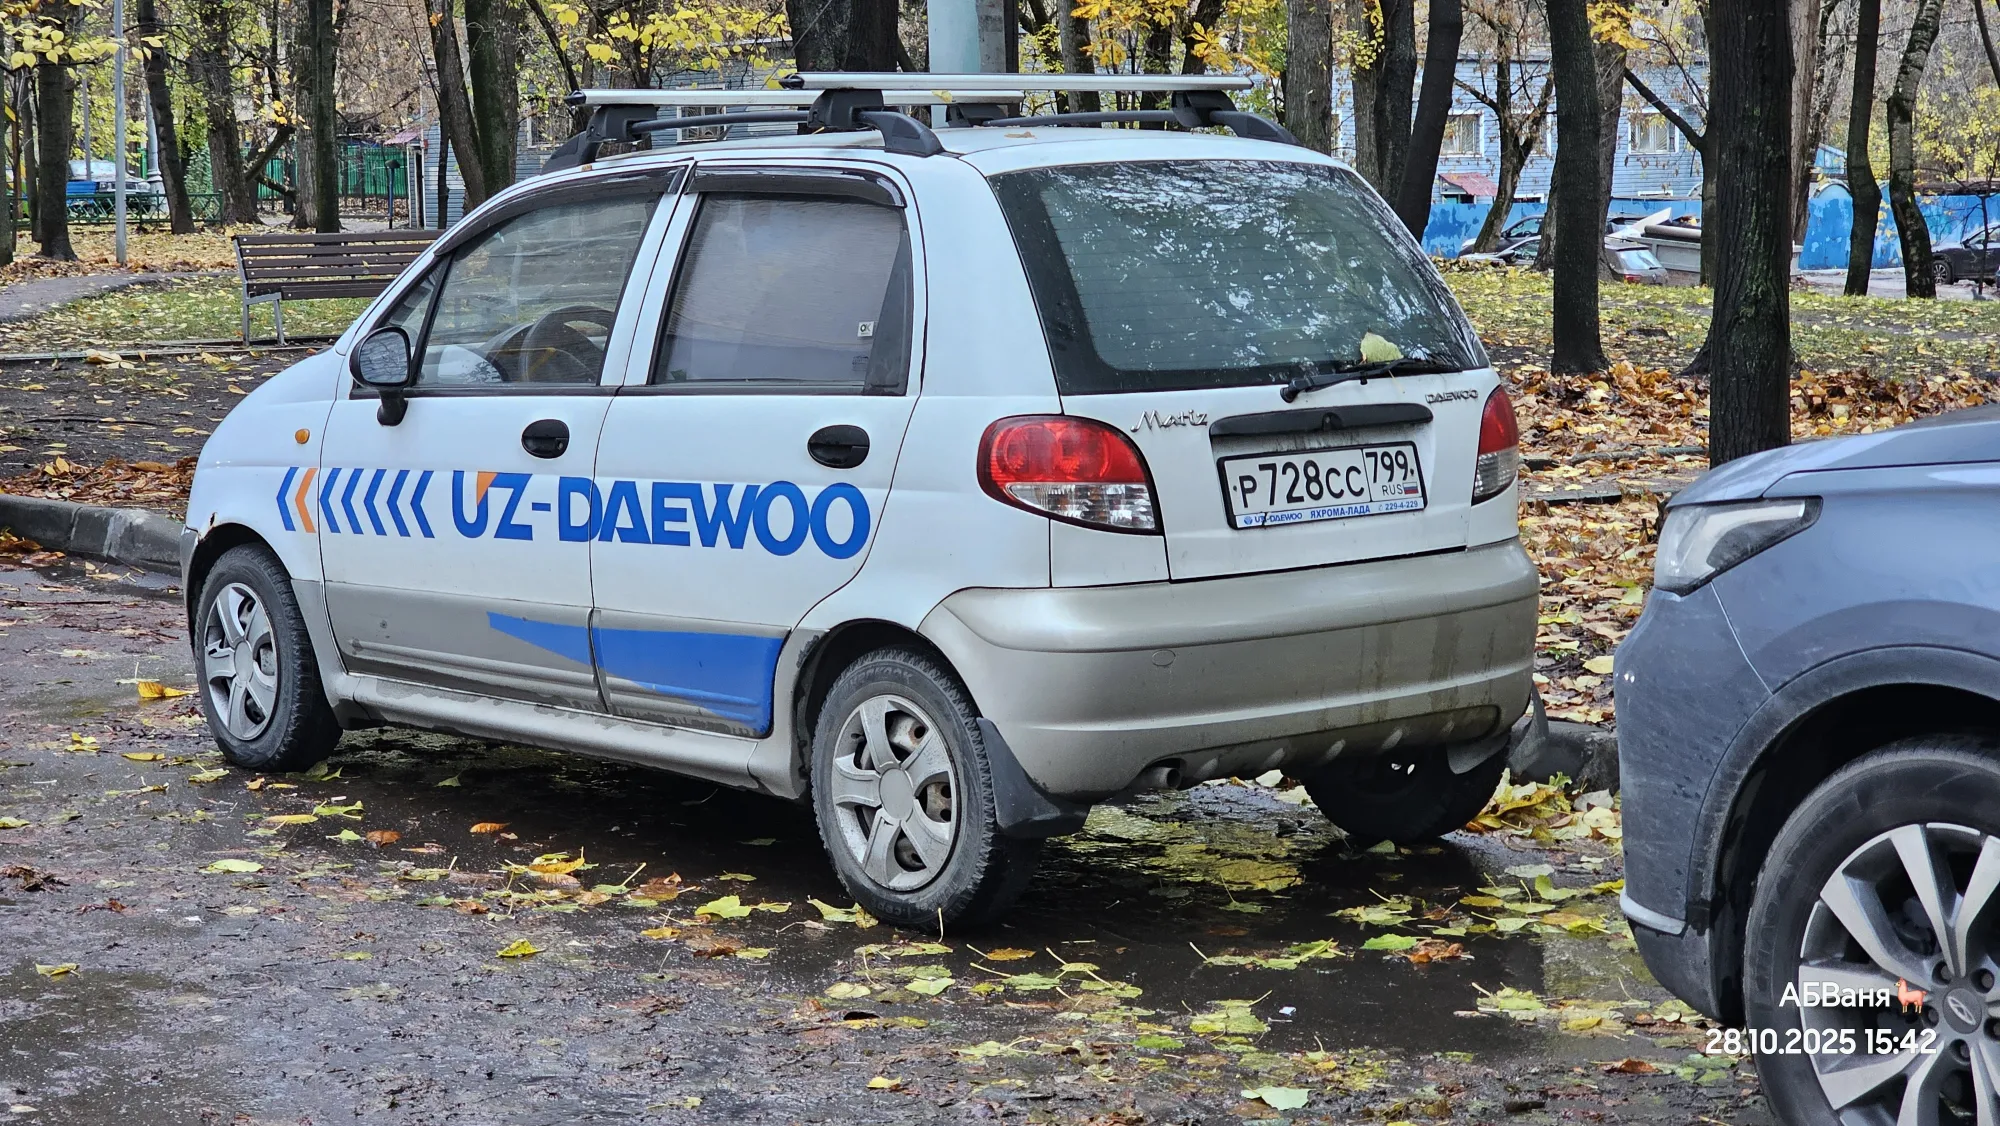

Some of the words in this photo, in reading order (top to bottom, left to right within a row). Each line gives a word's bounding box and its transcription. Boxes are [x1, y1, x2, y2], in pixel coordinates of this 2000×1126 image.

[1425, 389, 1478, 404] DAEWOO
[1130, 409, 1208, 433] Matiz
[1365, 450, 1408, 484] 799
[1382, 484, 1403, 496] RUS
[1310, 504, 1371, 519] ЯХРОМА-ЛАДА
[1385, 500, 1419, 511] 229-4-229
[452, 469, 871, 559] UZ-DAEWOO
